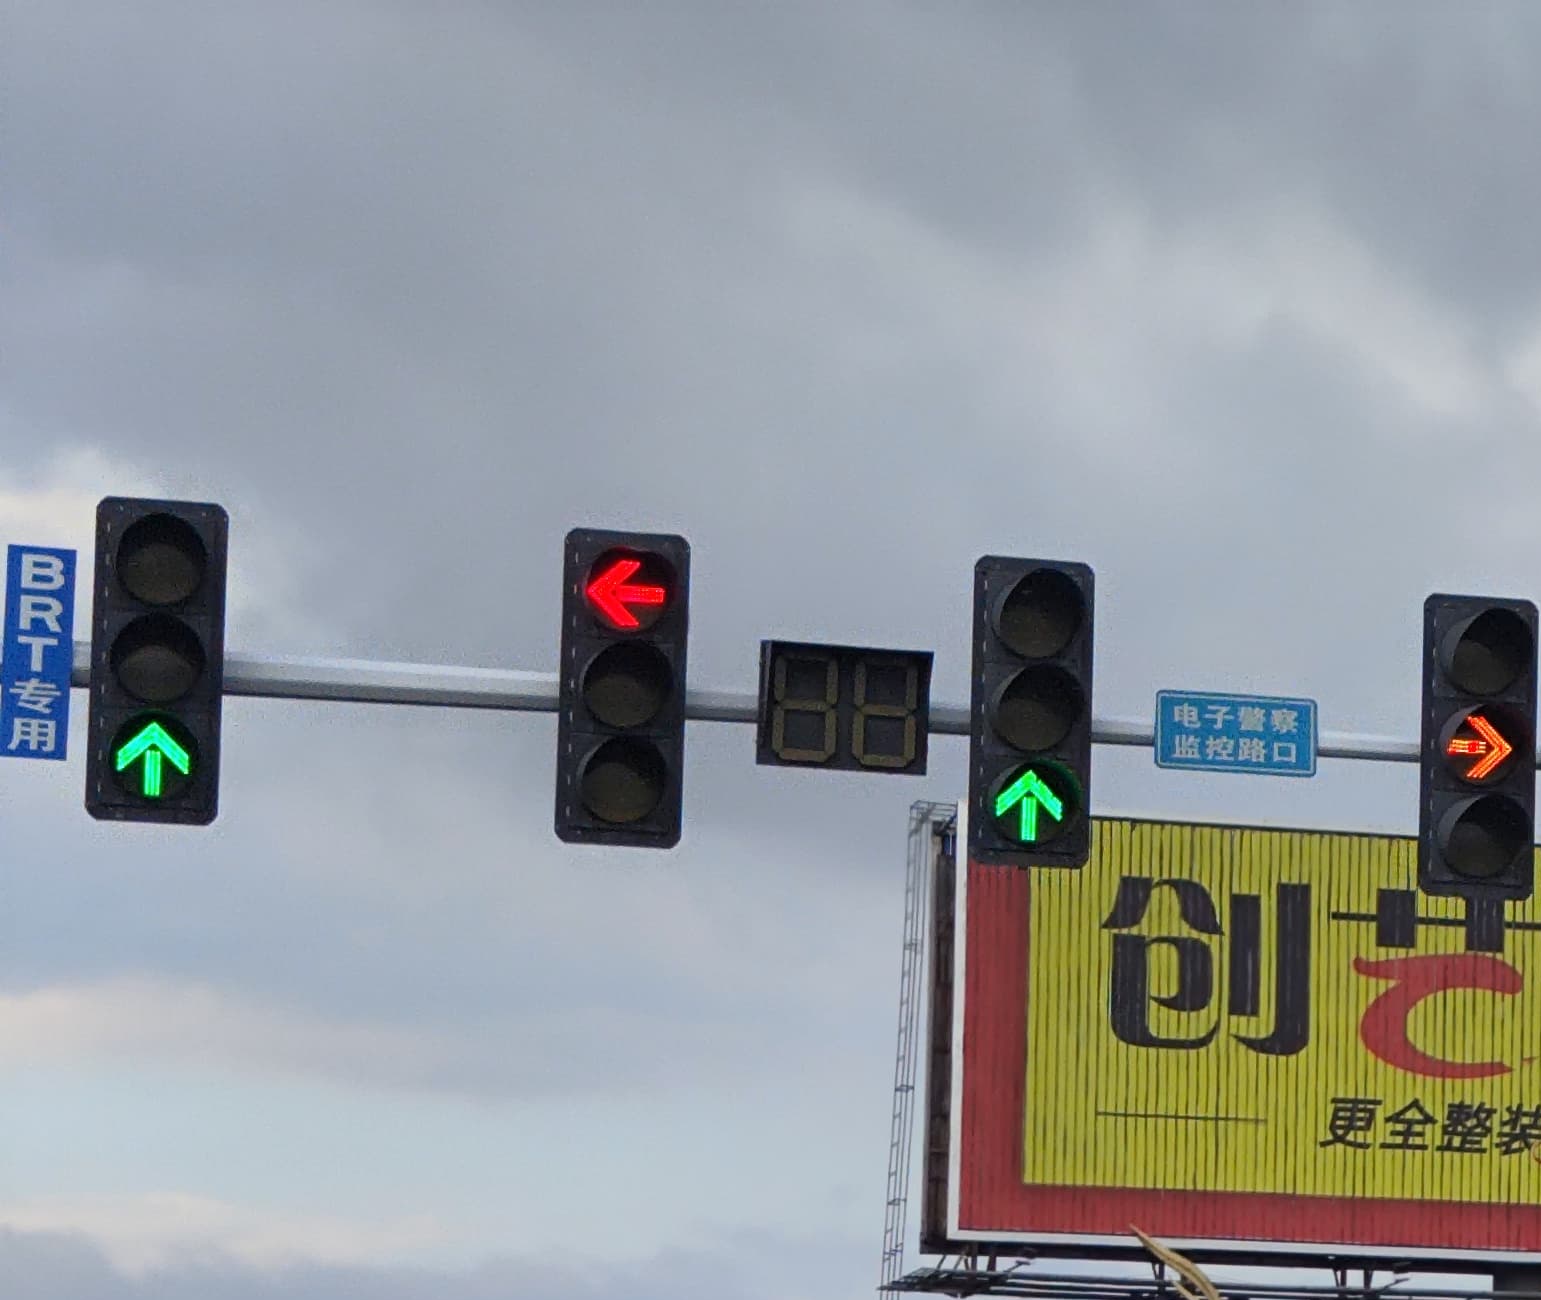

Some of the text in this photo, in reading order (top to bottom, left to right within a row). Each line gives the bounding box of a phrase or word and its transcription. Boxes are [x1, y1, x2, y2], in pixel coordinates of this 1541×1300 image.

[1172, 701, 1300, 735] 电子警察
[1173, 733, 1298, 765] 监控路口
